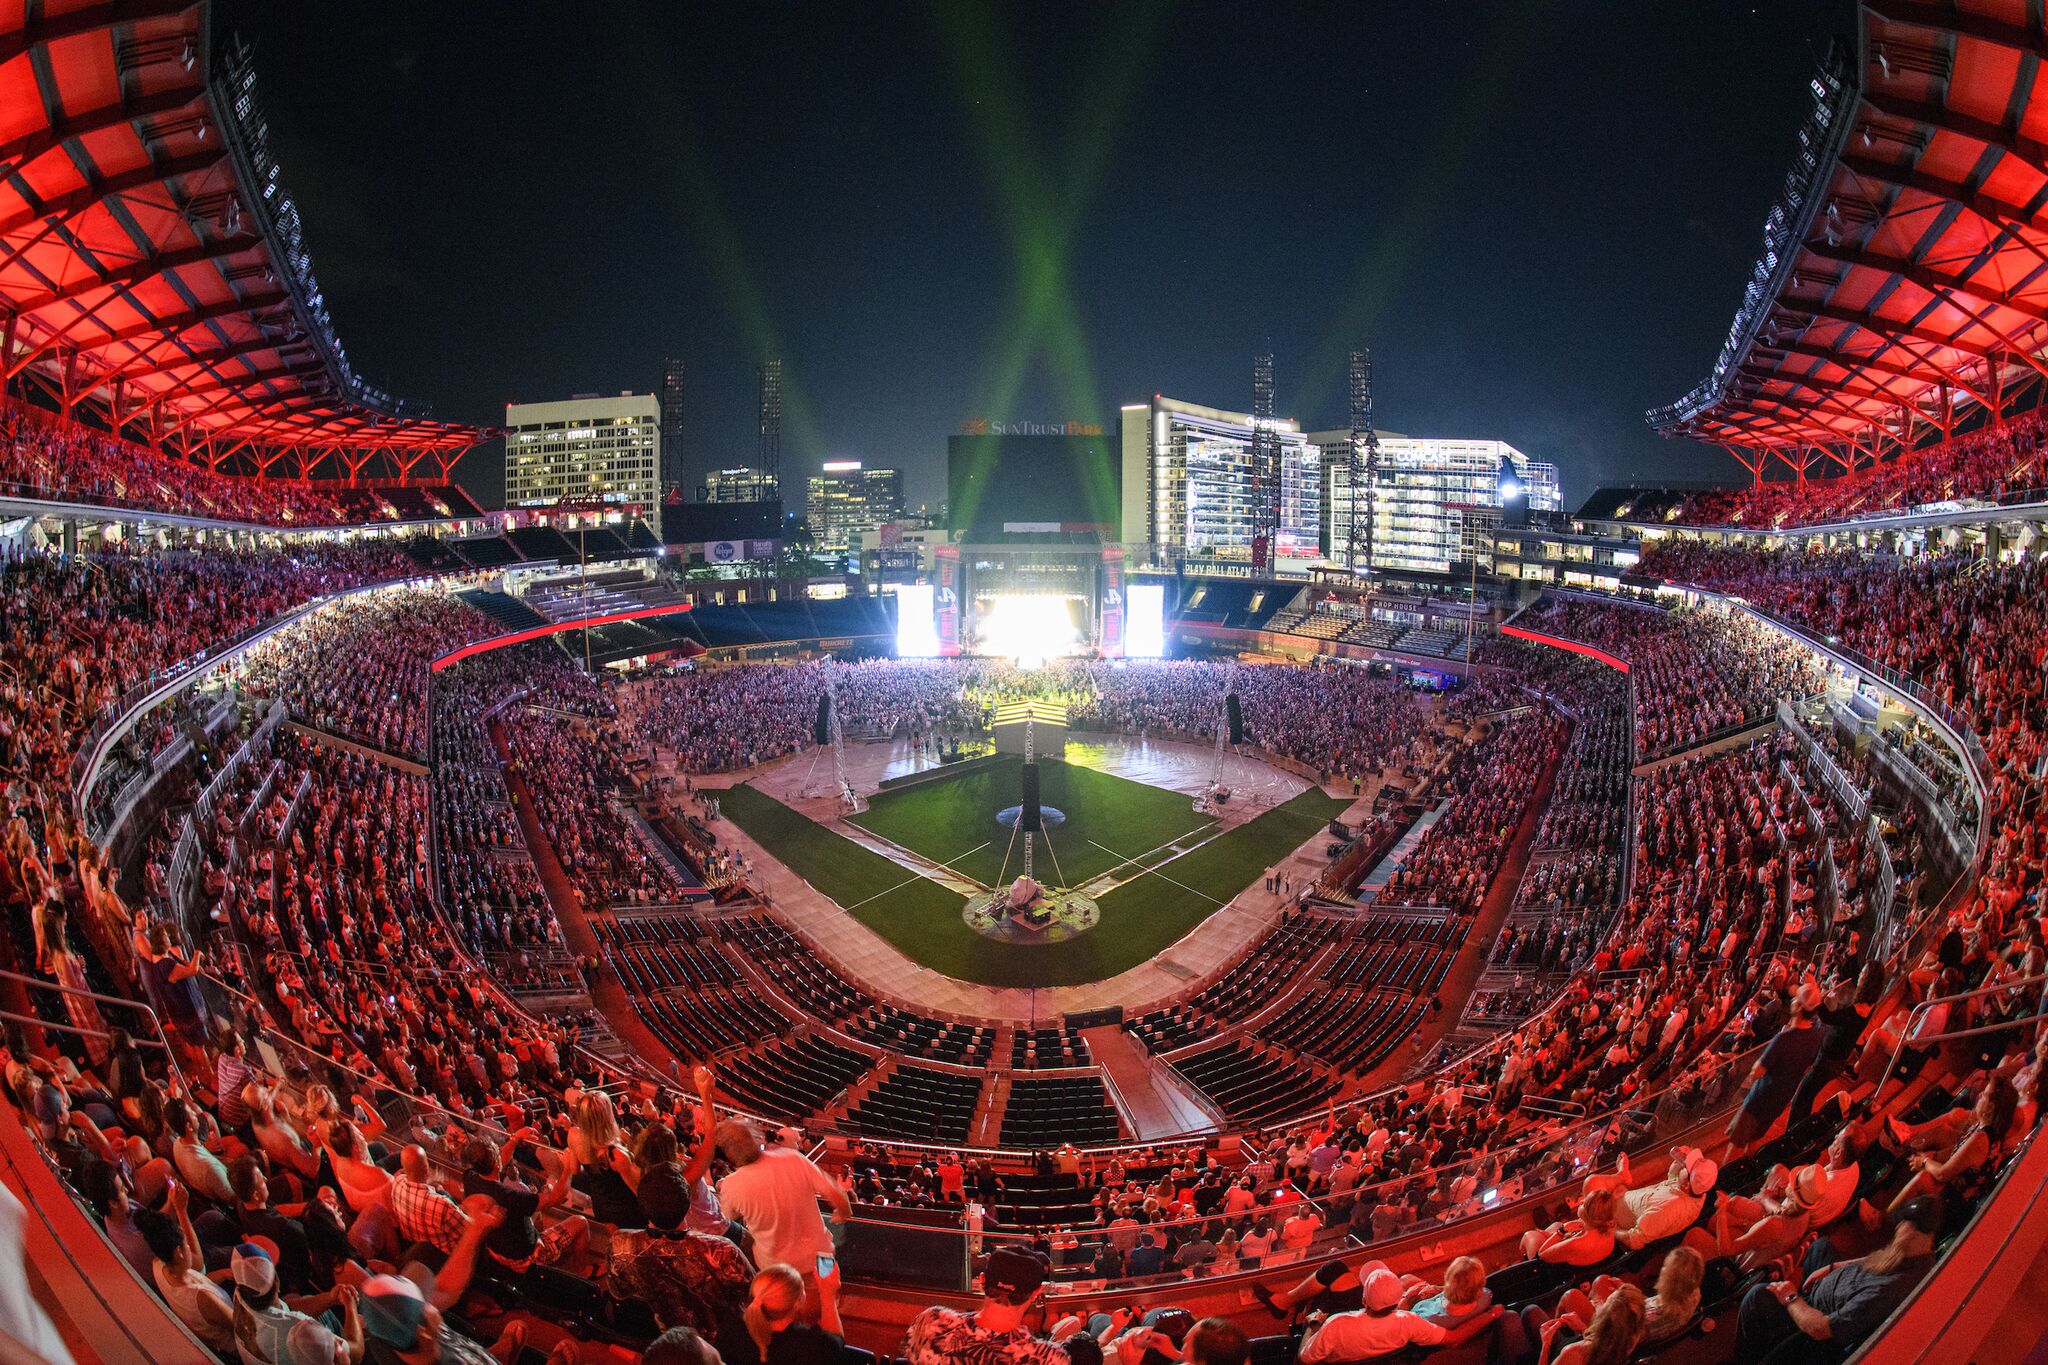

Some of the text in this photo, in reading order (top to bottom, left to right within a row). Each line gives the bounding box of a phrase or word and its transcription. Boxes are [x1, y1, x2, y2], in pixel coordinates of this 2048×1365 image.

[1185, 564, 1204, 575] PLAY
[1374, 600, 1417, 611] CHOP HOUSE
